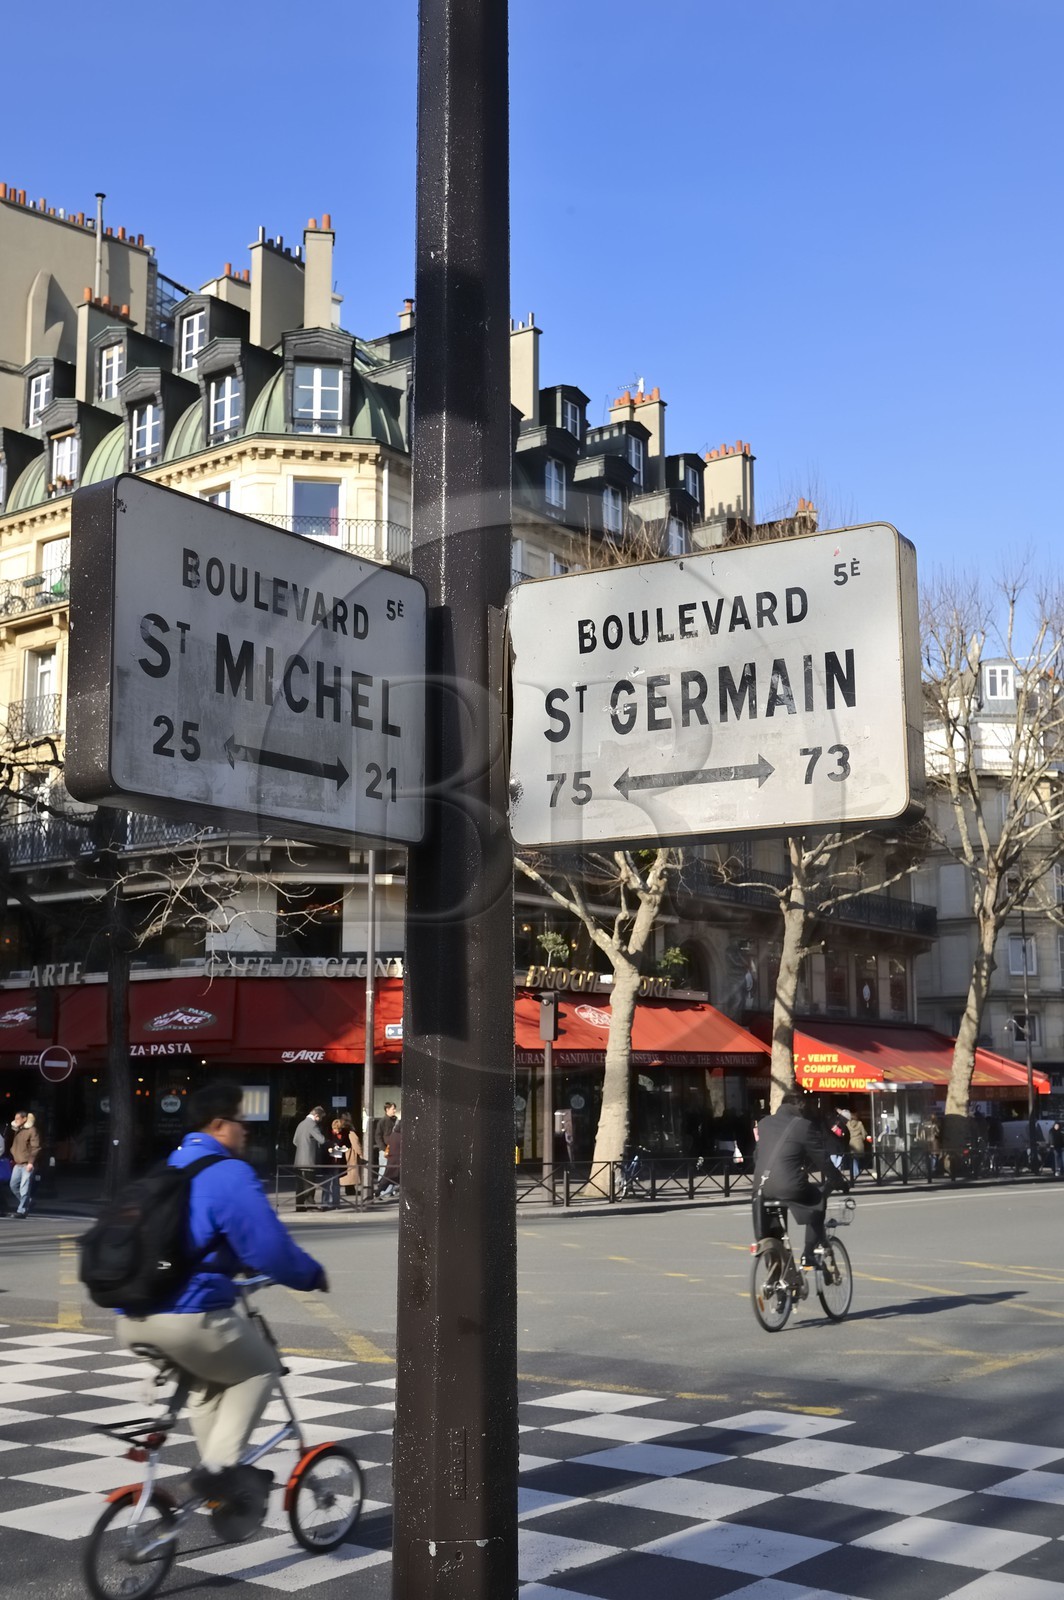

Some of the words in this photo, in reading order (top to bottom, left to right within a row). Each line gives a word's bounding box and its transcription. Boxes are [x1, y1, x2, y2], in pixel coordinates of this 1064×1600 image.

[182, 547, 369, 641] BOULEVARD
[578, 586, 809, 655] BOULEVARD
[215, 631, 402, 738] MICHEL
[610, 648, 857, 736] GERMAIN
[152, 714, 201, 763] 25
[365, 762, 397, 803] 21
[799, 743, 851, 785] 73
[546, 770, 593, 809] 75
[29, 961, 82, 988] ARTE
[204, 956, 272, 978] CAFE
[278, 956, 314, 978] DE
[525, 964, 603, 993] BRIOCHE
[130, 1042, 192, 1056] ZA-PASTA
[808, 1054, 839, 1063] VENTE
[802, 1077, 814, 1089] K7
[803, 1064, 856, 1074] COMPTANT
